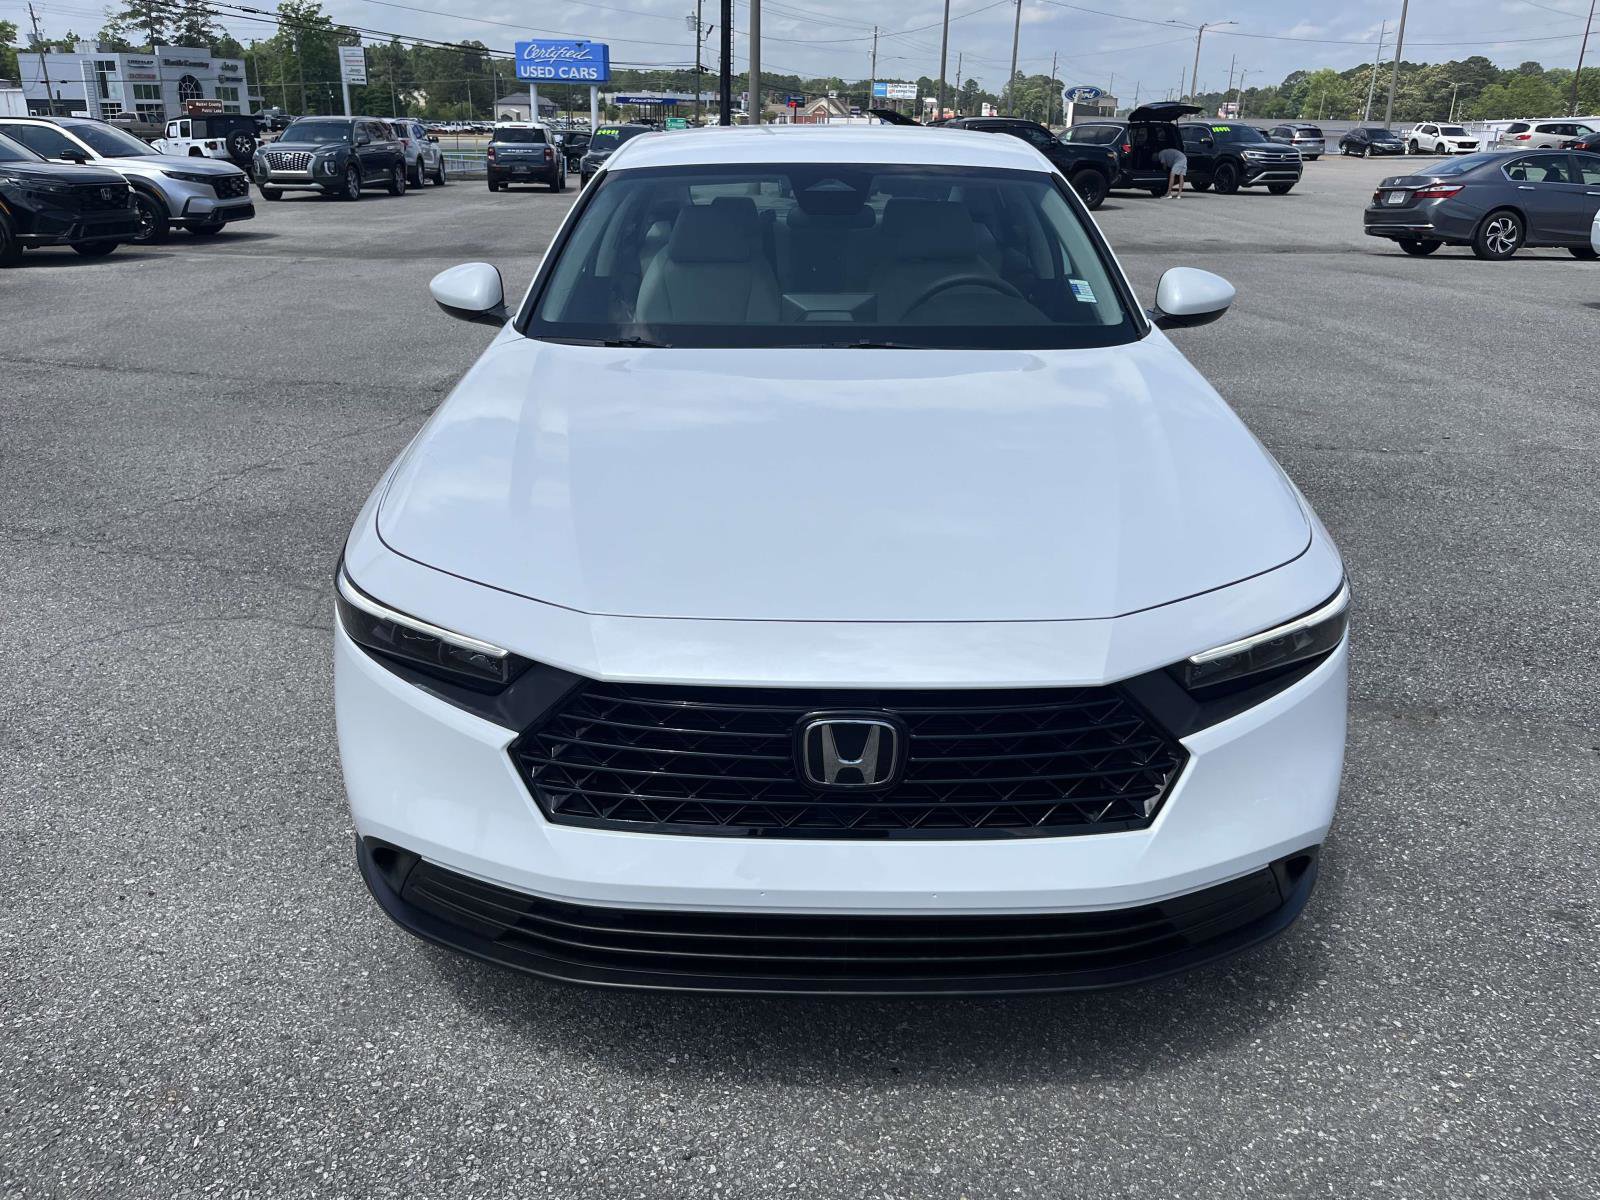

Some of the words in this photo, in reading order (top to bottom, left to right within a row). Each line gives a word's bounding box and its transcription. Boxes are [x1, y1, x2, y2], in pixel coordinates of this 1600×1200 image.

[523, 44, 592, 64] Certified
[520, 66, 555, 78] USED
[559, 67, 597, 79] CARS
